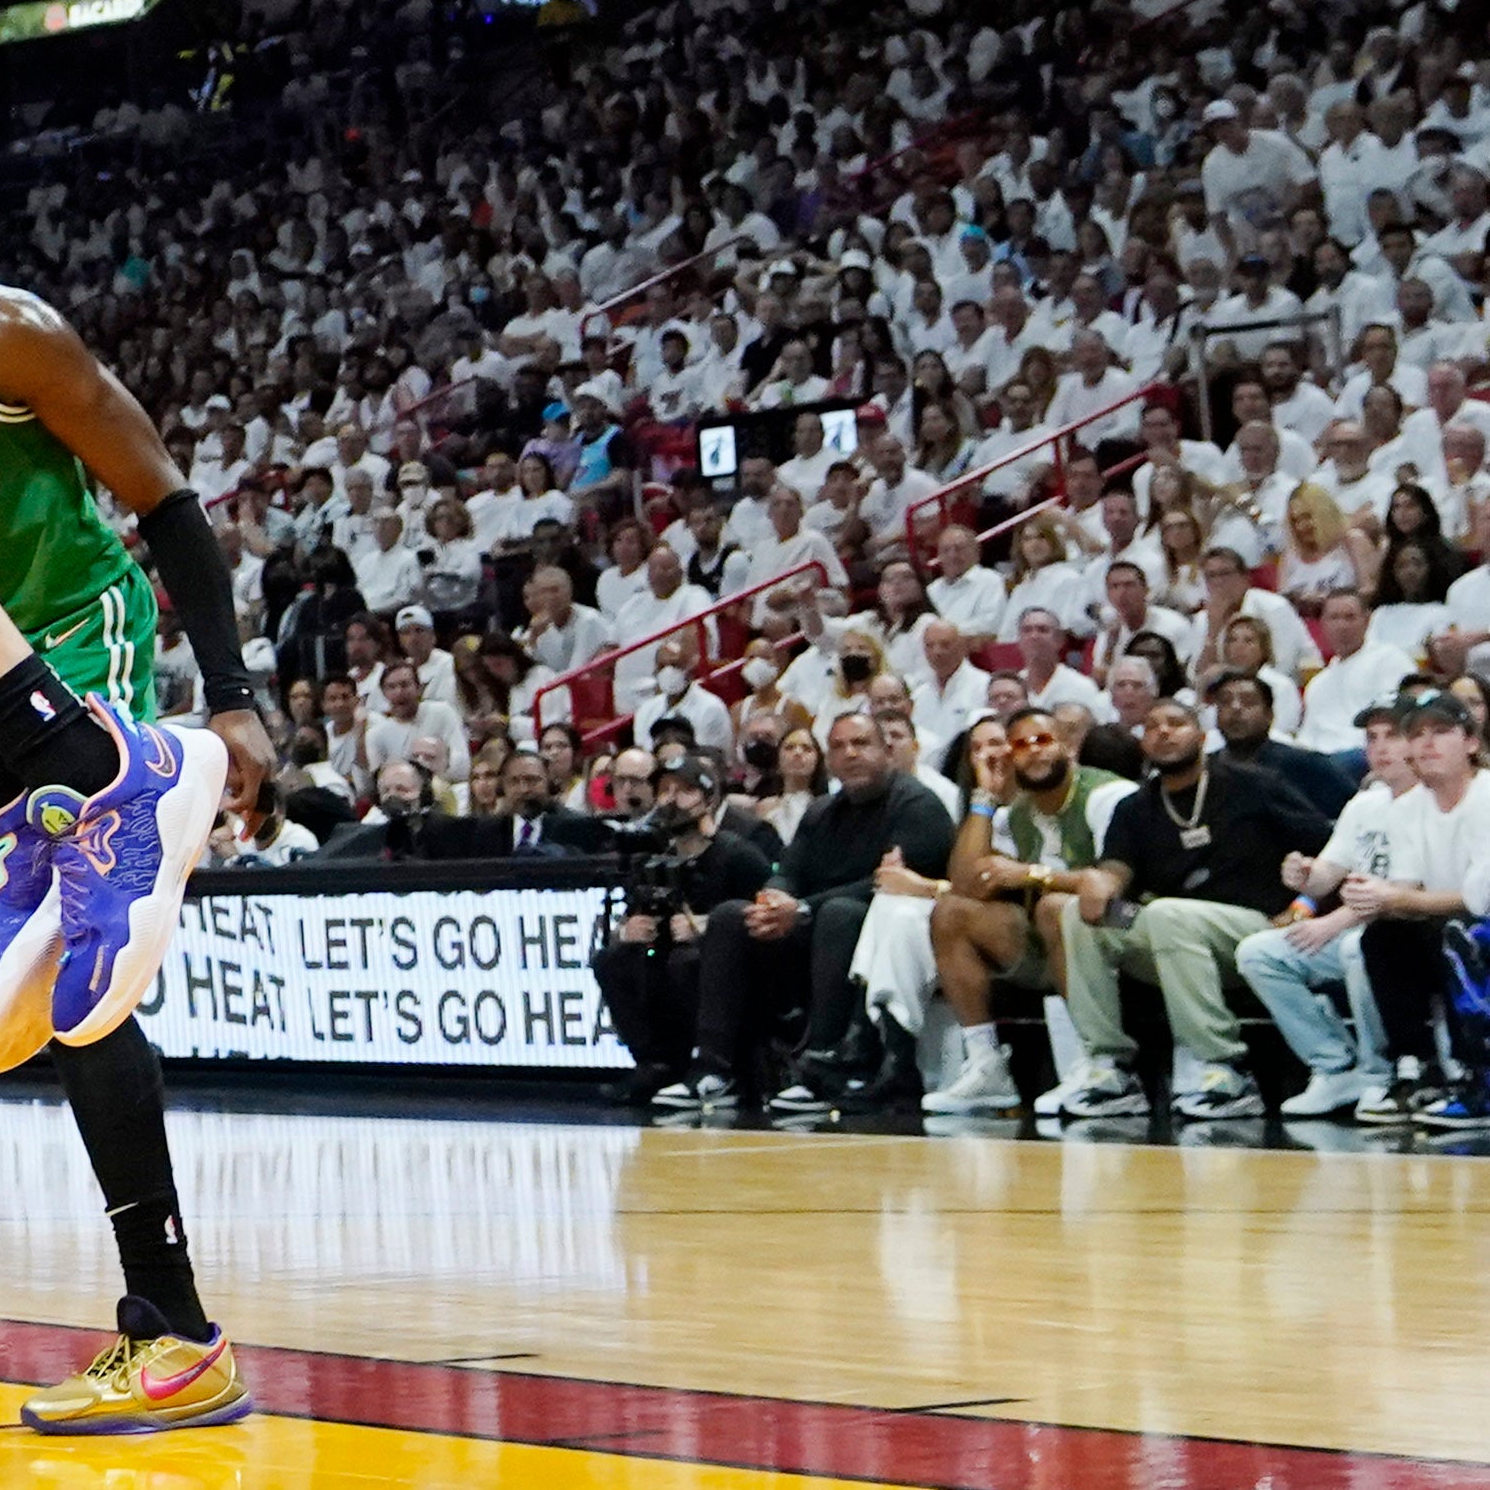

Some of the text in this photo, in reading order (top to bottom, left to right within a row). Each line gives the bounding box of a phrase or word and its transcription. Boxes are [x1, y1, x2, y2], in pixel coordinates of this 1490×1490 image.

[298, 915, 418, 971] LET'S
[433, 914, 502, 971] GO
[182, 951, 287, 1032] HEAT
[306, 986, 423, 1045] LET'S
[438, 989, 508, 1047] GO
